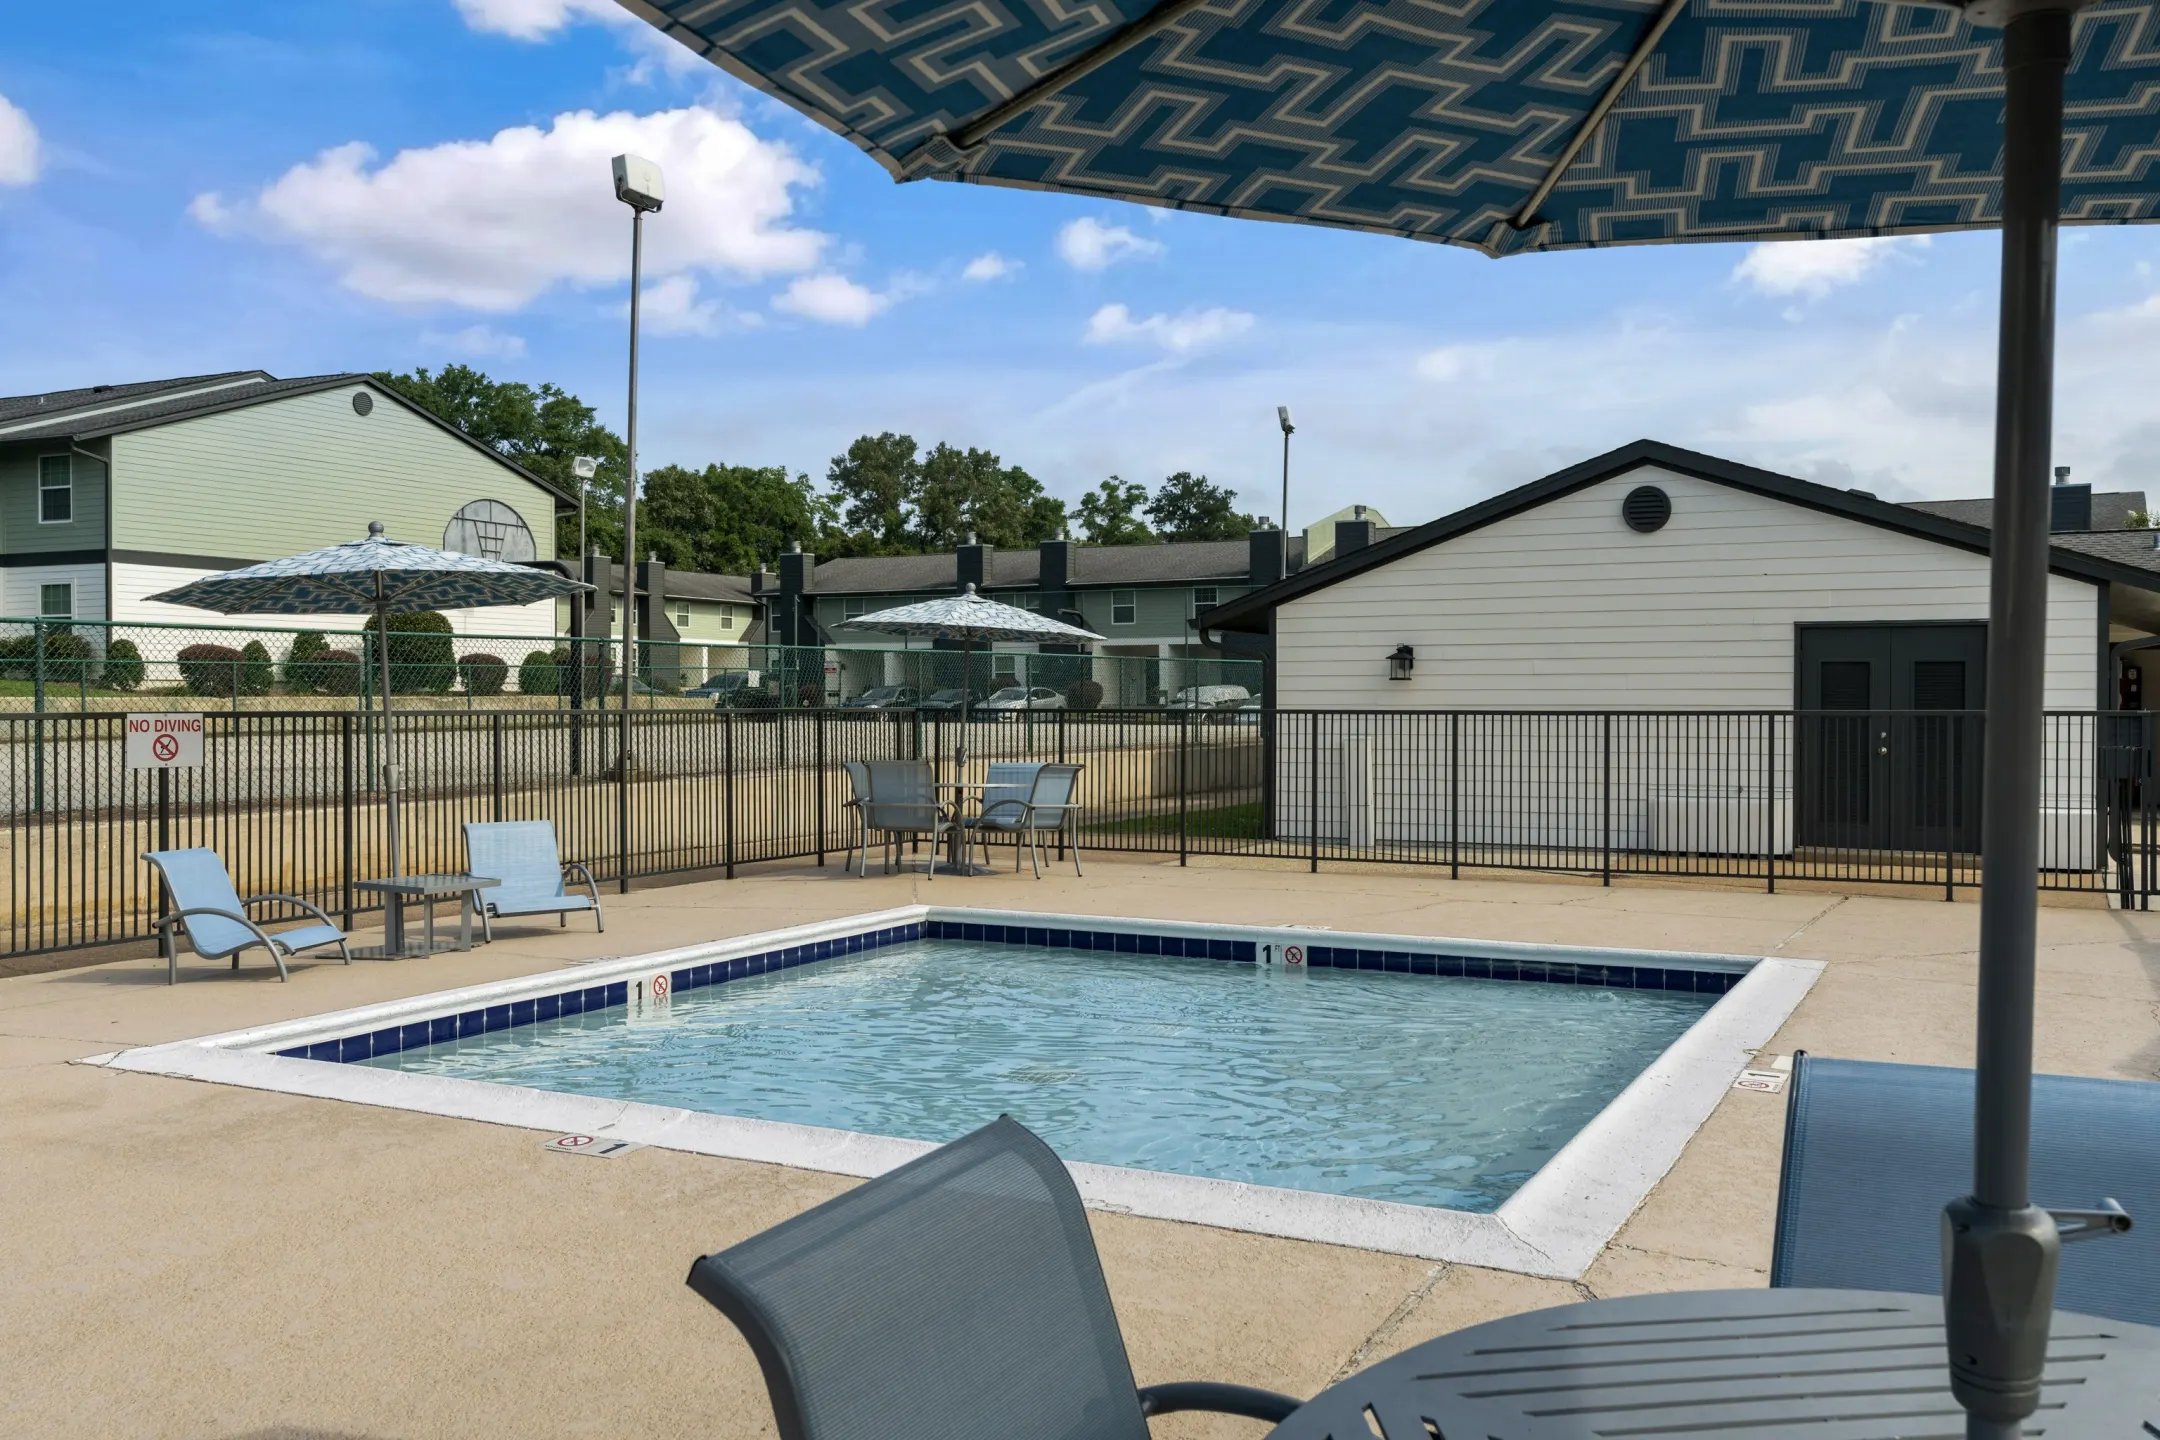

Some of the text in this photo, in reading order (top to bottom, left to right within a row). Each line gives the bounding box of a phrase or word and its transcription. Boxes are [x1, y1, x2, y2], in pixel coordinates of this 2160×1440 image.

[129, 719, 202, 733] NO DIVING
[1262, 944, 1272, 964] 1
[635, 980, 643, 1000] 1
[598, 1143, 630, 1155] 1
